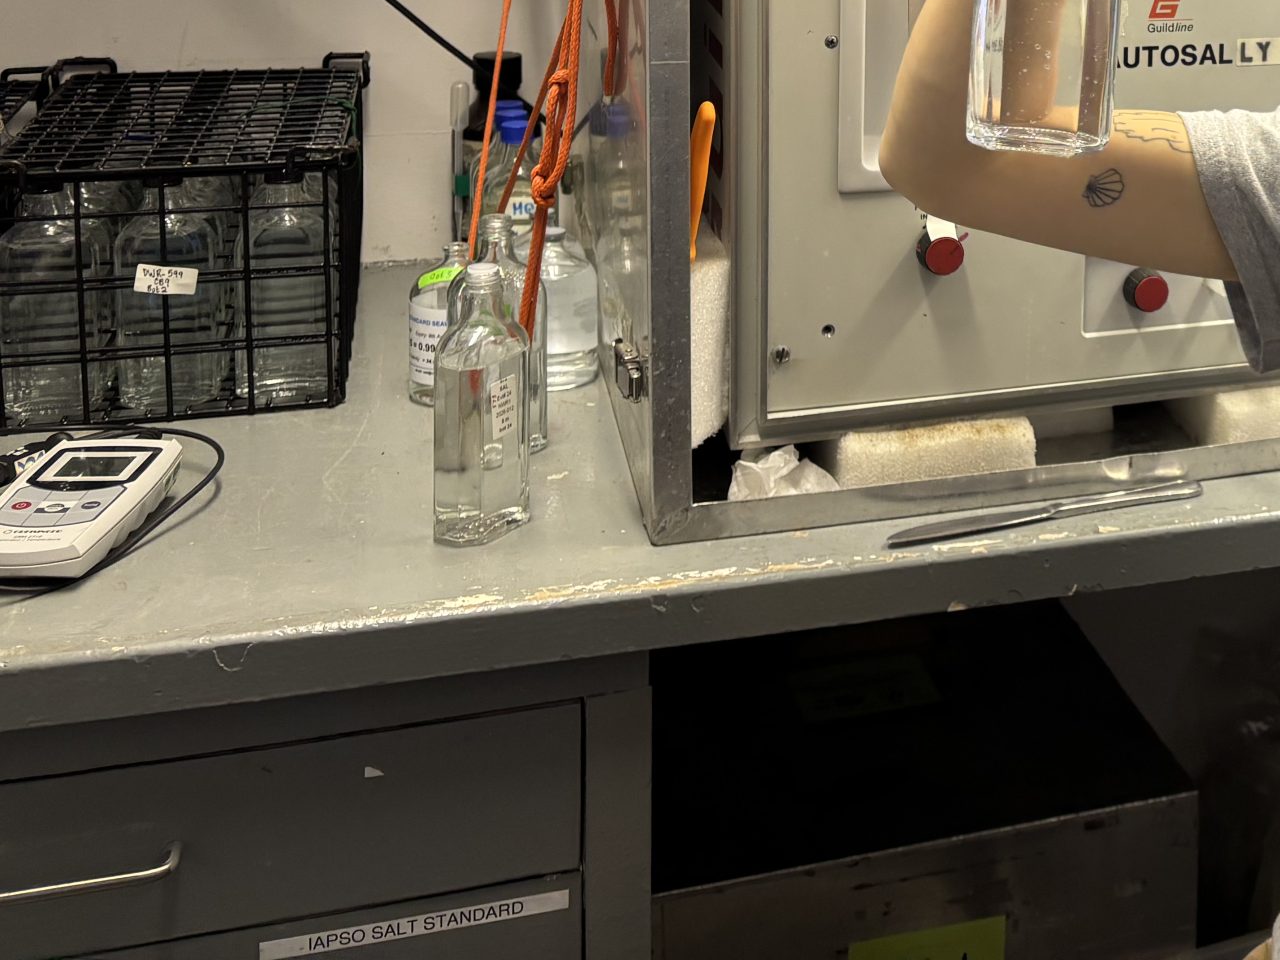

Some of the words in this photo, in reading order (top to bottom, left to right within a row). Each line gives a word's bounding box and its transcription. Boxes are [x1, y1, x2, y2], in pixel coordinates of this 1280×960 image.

[1147, 22, 1194, 34] Guildline
[307, 928, 366, 953] IAPSO
[371, 920, 416, 940] SALT
[423, 900, 524, 932] STANDARD
